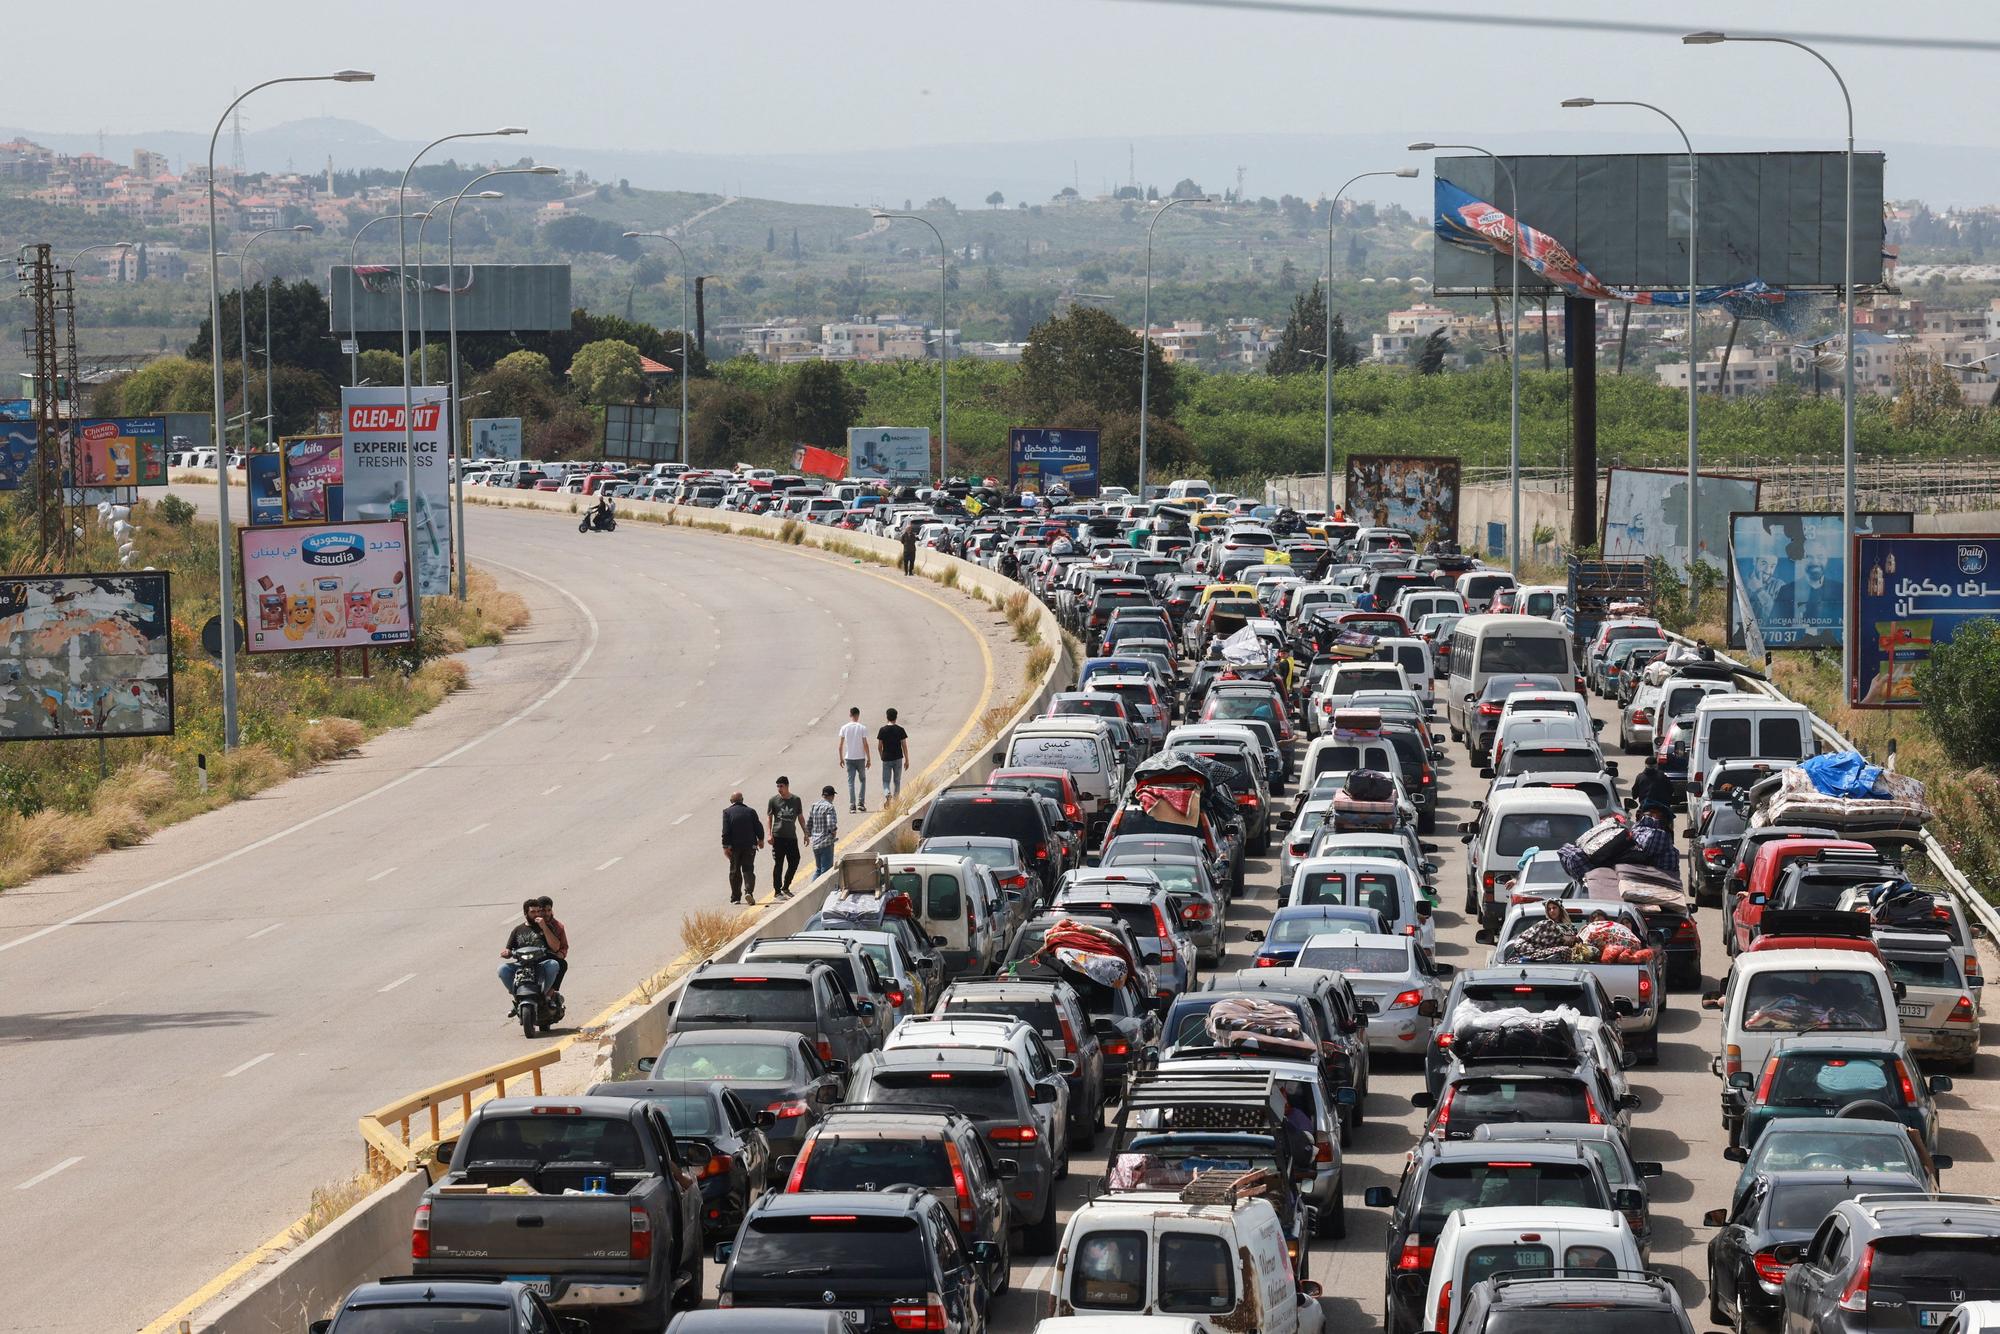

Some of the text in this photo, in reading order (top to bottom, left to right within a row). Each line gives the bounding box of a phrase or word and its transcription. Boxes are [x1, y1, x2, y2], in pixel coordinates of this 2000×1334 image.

[353, 409, 434, 428] CLEO-DNT
[304, 442, 323, 455] kita
[310, 535, 356, 548] السعودية
[369, 539, 401, 553] جديد
[250, 544, 297, 560] في لبنان
[313, 552, 355, 565] saudia
[1959, 547, 1984, 559] Daily
[1769, 617, 1801, 625] HICHAM
[1802, 617, 1832, 625] HADDAD
[1769, 631, 1783, 641] 70
[1784, 631, 1797, 642] 37
[1039, 740, 1071, 751] عيسى
[1898, 1006, 1921, 1015] 10133
[1930, 1312, 1938, 1325] N
